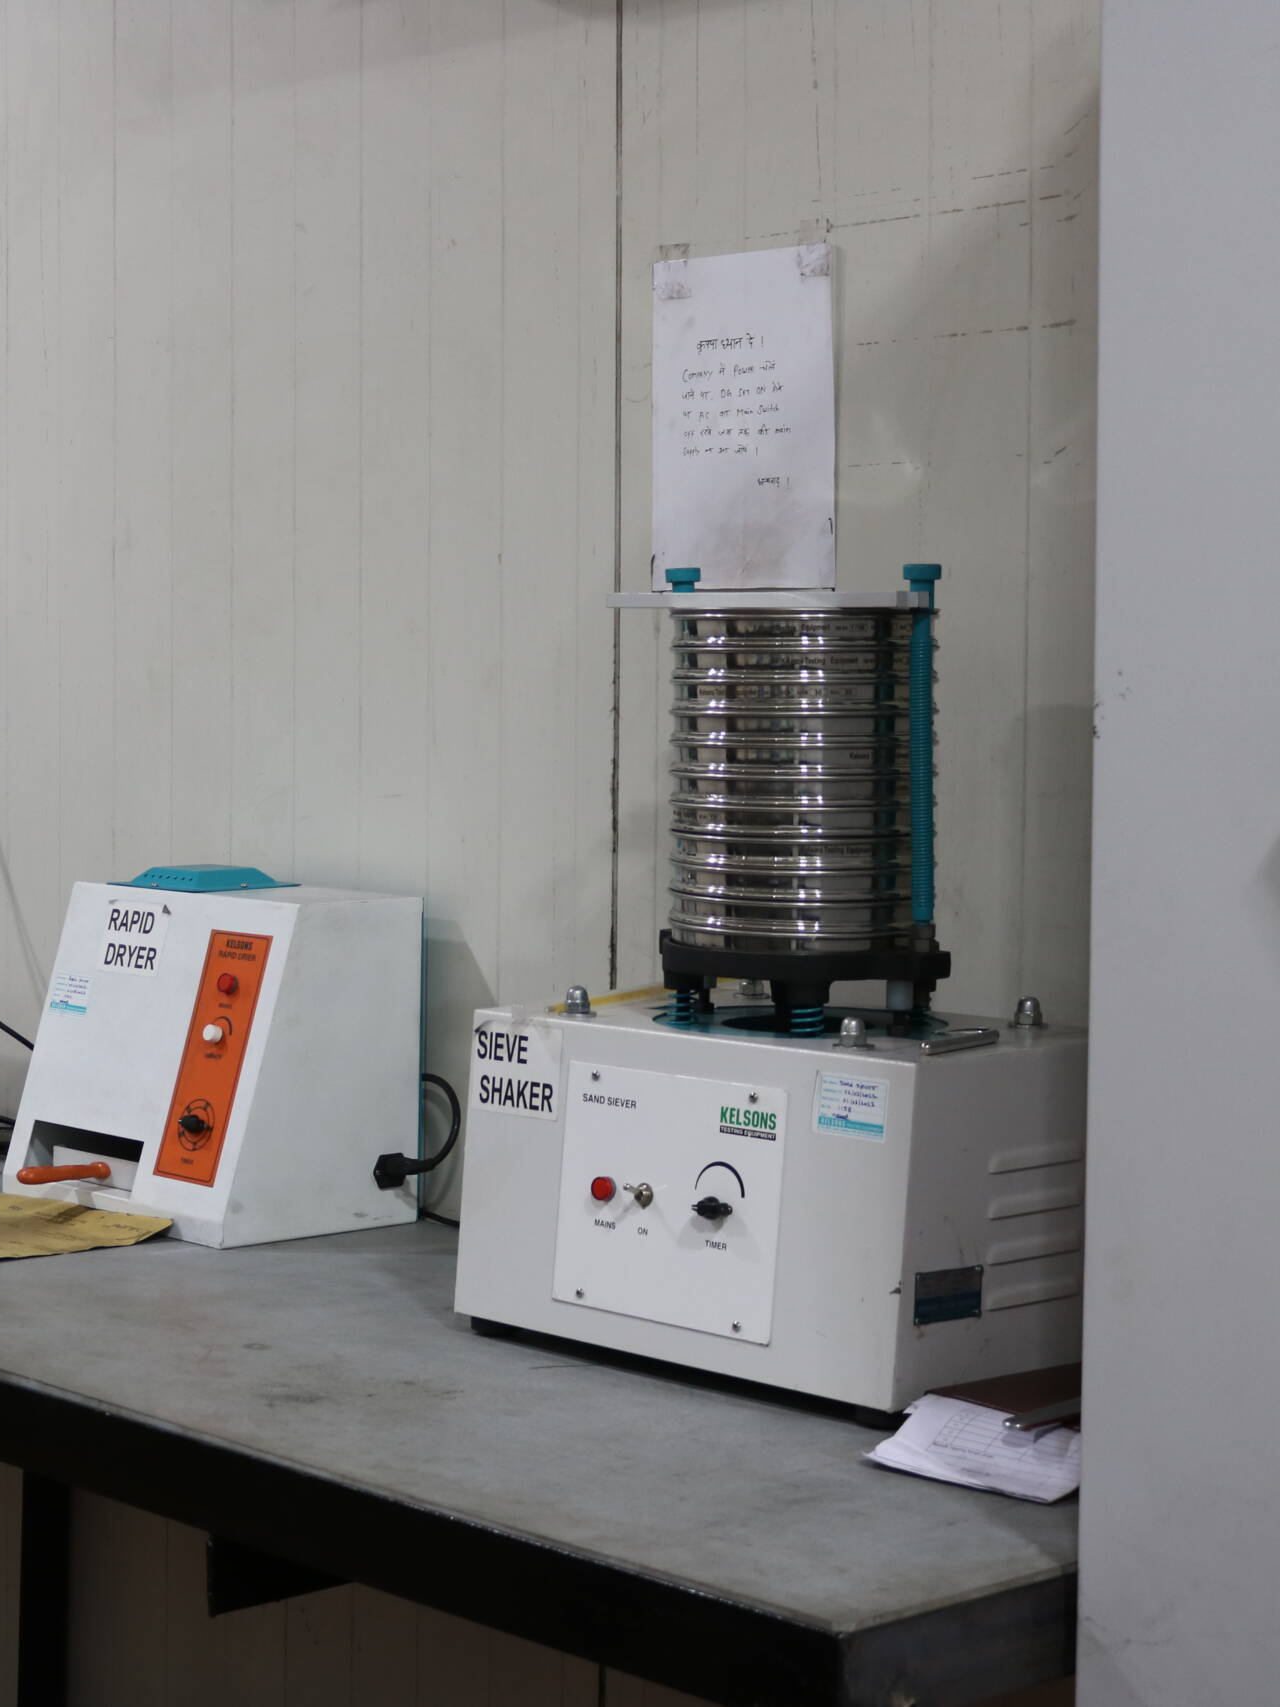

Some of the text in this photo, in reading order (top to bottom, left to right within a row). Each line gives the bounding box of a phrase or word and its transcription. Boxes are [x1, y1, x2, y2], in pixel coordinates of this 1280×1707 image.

[108, 908, 155, 934] RAPID
[104, 942, 157, 970] DRYER
[477, 1030, 528, 1065] SIEVE
[479, 1074, 553, 1113] SHAKER
[582, 1093, 637, 1110] SAND SIEVER
[719, 1105, 777, 1131] KELSONS
[594, 1219, 617, 1230] MAINS
[637, 1226, 649, 1236] ON
[705, 1240, 727, 1251] TIMER
